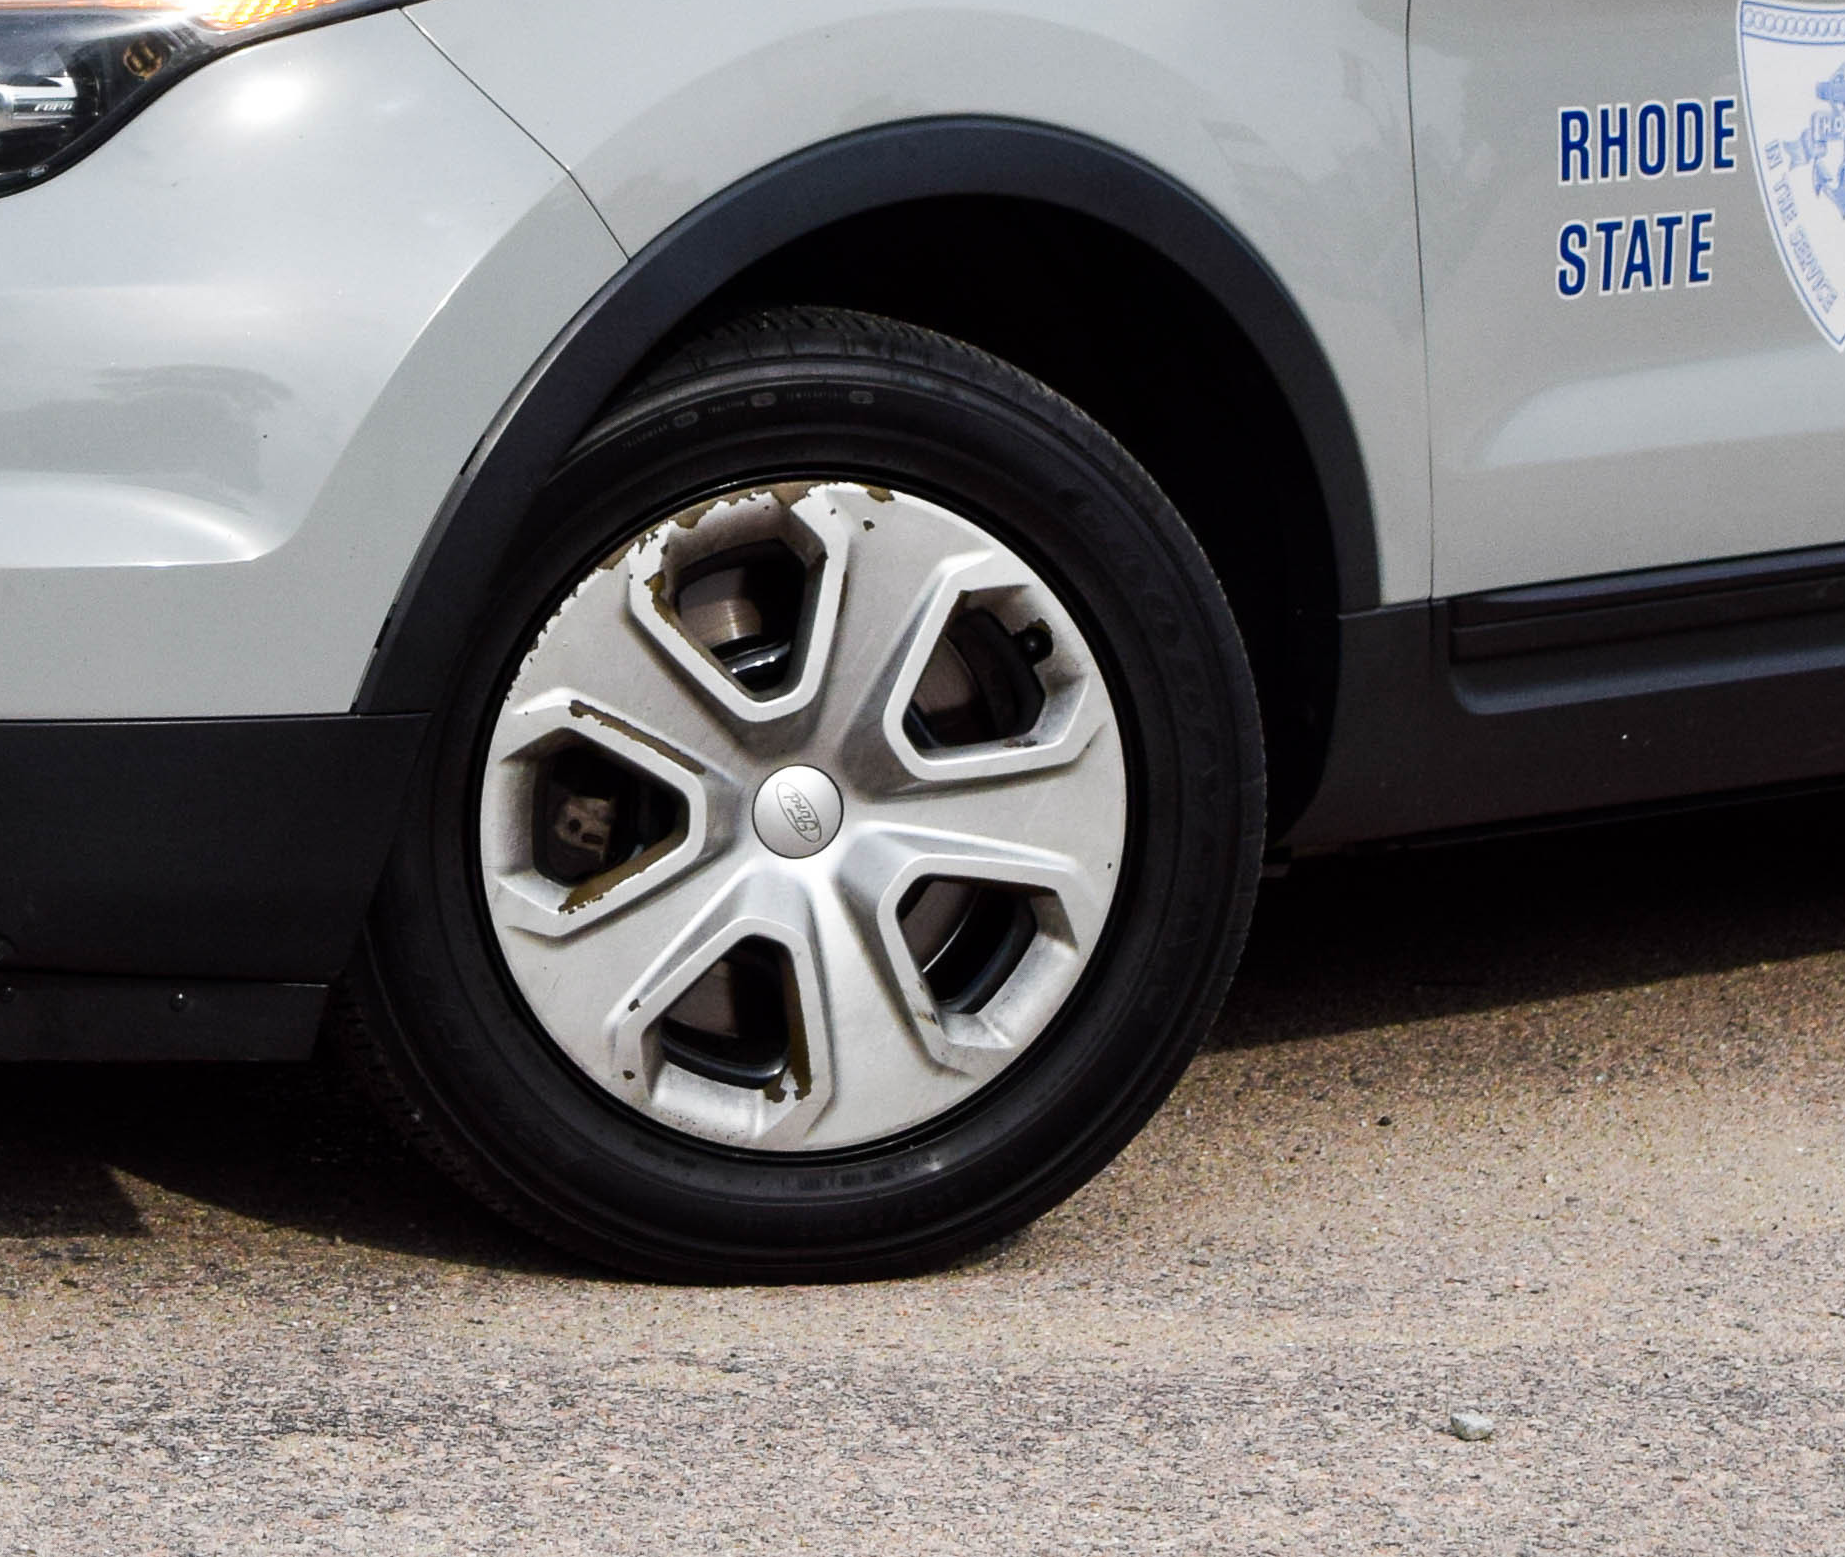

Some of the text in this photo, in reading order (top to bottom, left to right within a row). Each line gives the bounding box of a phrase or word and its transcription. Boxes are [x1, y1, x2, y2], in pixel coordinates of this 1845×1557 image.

[1558, 95, 1738, 185] RHODE
[1556, 209, 1715, 299] STATE
[783, 791, 820, 832] Ford
